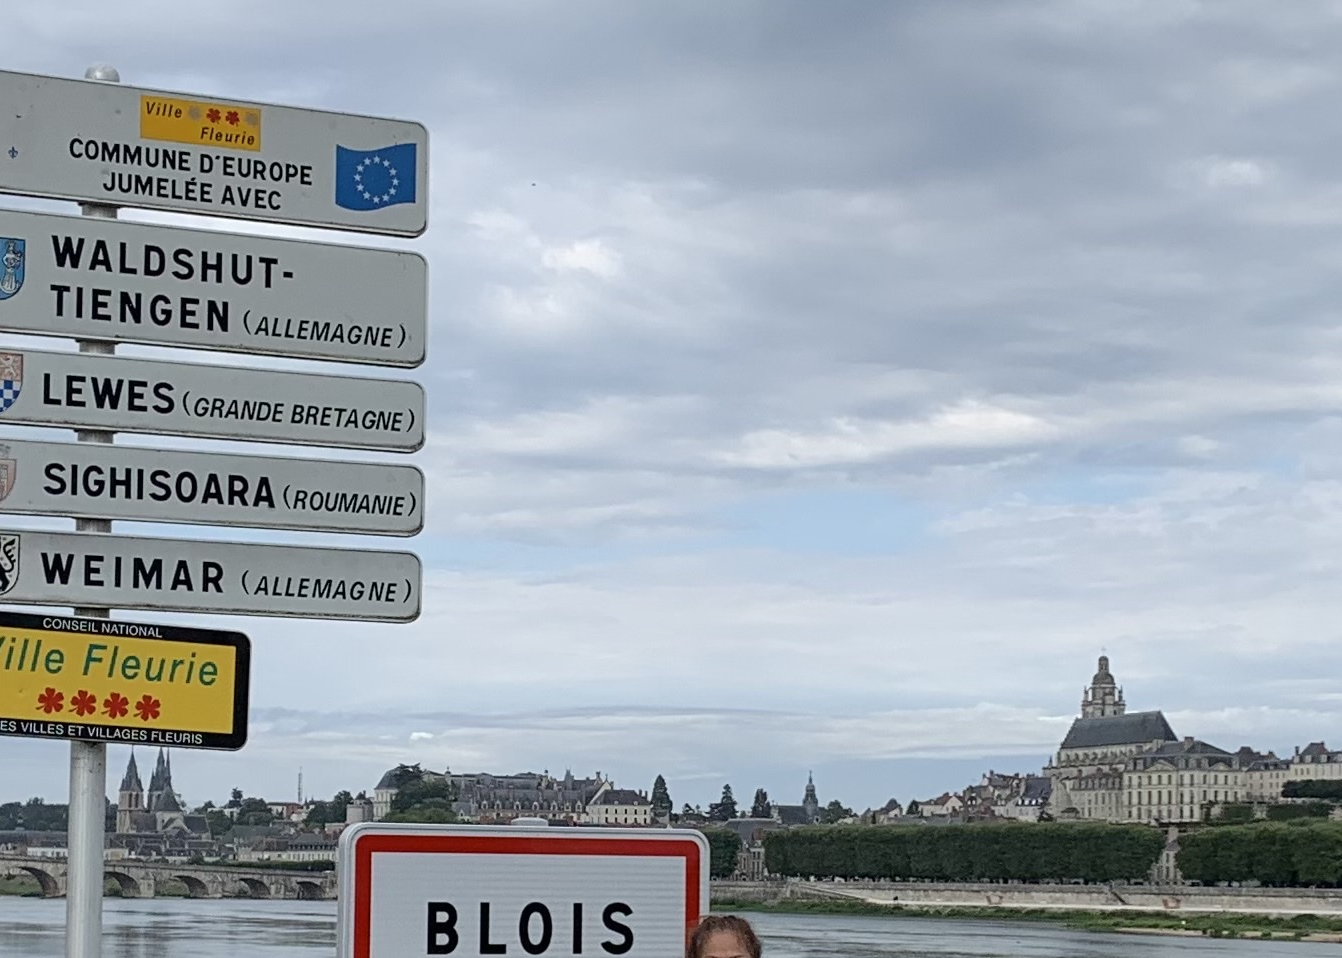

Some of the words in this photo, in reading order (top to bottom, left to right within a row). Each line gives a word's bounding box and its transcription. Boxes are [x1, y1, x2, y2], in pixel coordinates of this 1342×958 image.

[145, 101, 183, 119] Ville
[200, 126, 256, 146] Fleurie
[69, 138, 191, 171] COMMUNE
[199, 153, 313, 185] D'EUROPE
[103, 172, 213, 203] JUMELÉE
[221, 185, 282, 211] AVEC
[51, 234, 294, 288] WALDSHUT-
[50, 284, 229, 332] TIENGEN
[243, 309, 407, 349] (ALLEMAGNE)
[42, 373, 175, 414] LEWES
[182, 390, 285, 423] (GRANDE
[290, 404, 415, 433] BRETAGNE)
[43, 463, 276, 509] SIGHISOARA
[283, 484, 417, 517] (ROUMANIE)
[41, 552, 224, 593] WEIMAR
[241, 569, 412, 604] (ALLEMAGNE)
[42, 617, 99, 633] CONSEIL
[101, 623, 163, 638] NATIONAL
[82, 643, 218, 686] Fleurie
[20, 721, 65, 736] VILLES
[67, 724, 84, 737] ET
[87, 726, 148, 742] VILLAGES
[150, 729, 203, 745] FLEURIS
[426, 901, 635, 955] BLOIS
